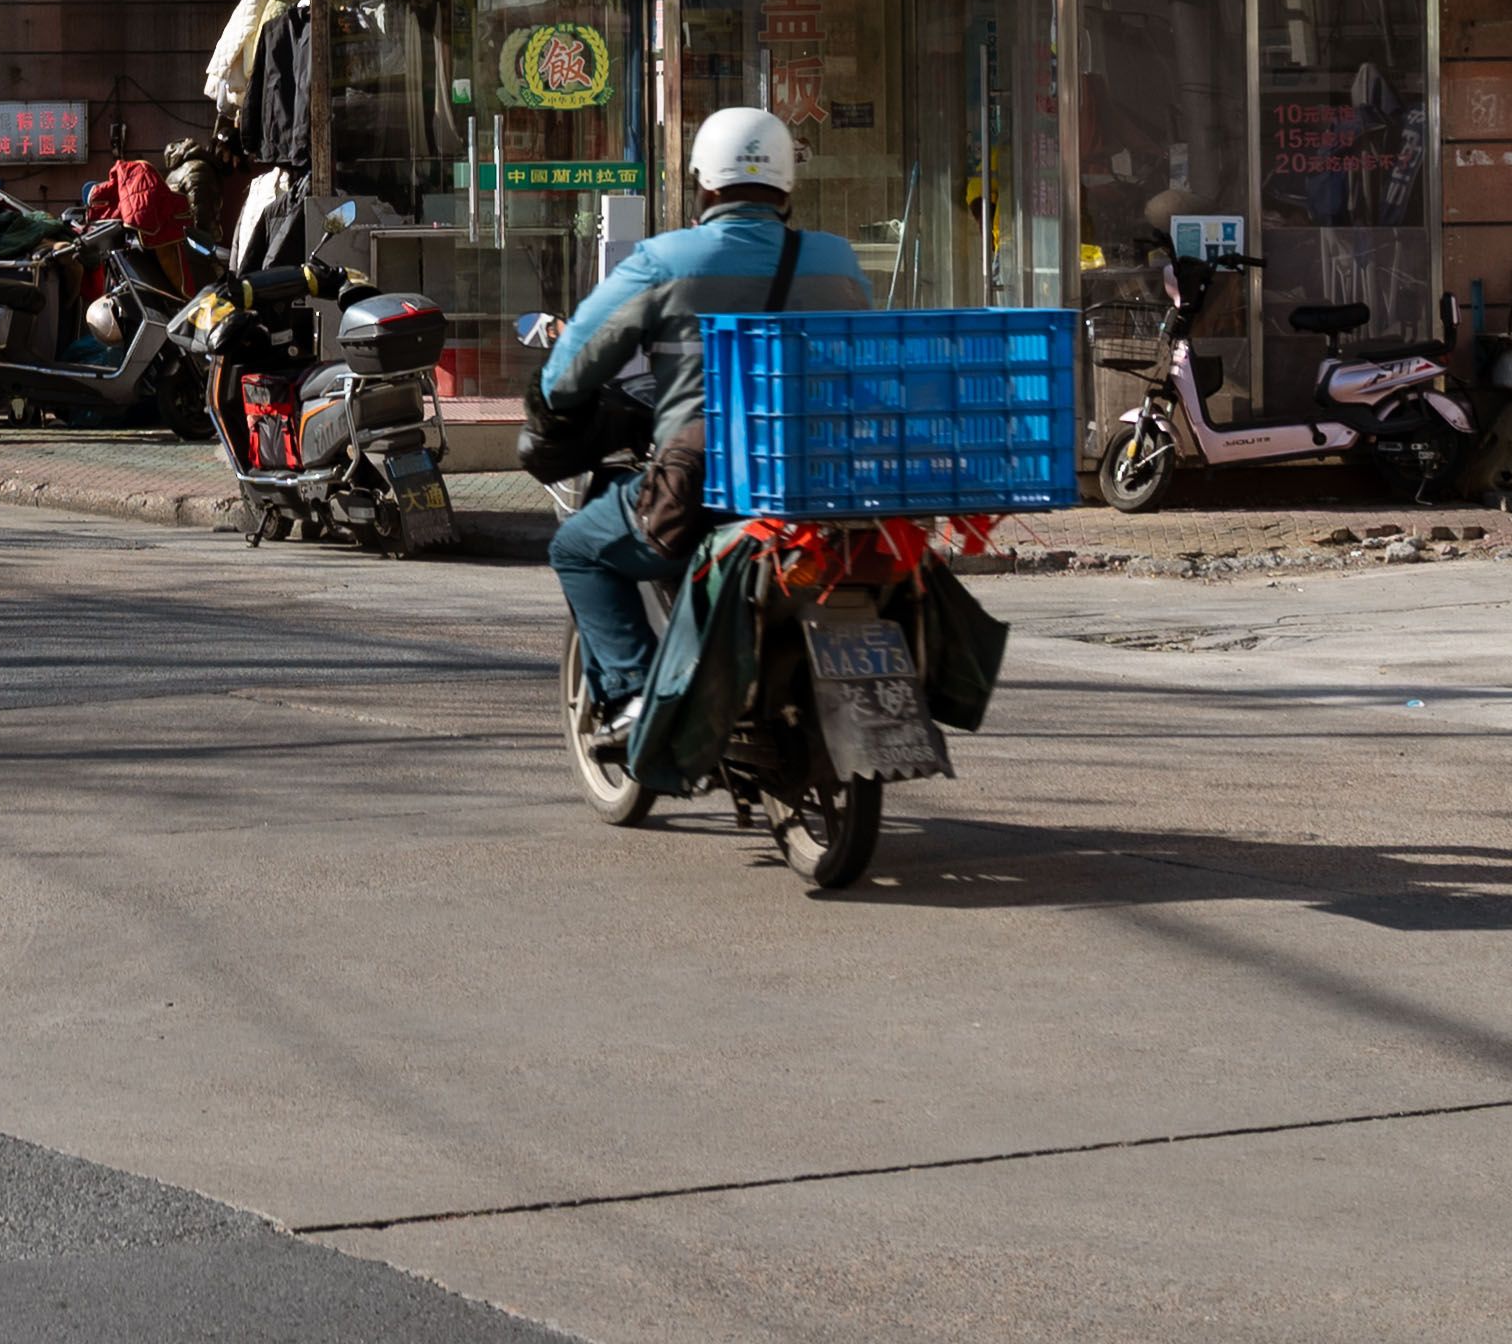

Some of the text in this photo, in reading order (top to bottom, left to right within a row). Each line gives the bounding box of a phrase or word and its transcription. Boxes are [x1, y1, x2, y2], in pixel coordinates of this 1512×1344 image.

[538, 36, 594, 90] 飯
[507, 168, 638, 185] 中國蘭州拉面
[402, 482, 447, 512] 大通
